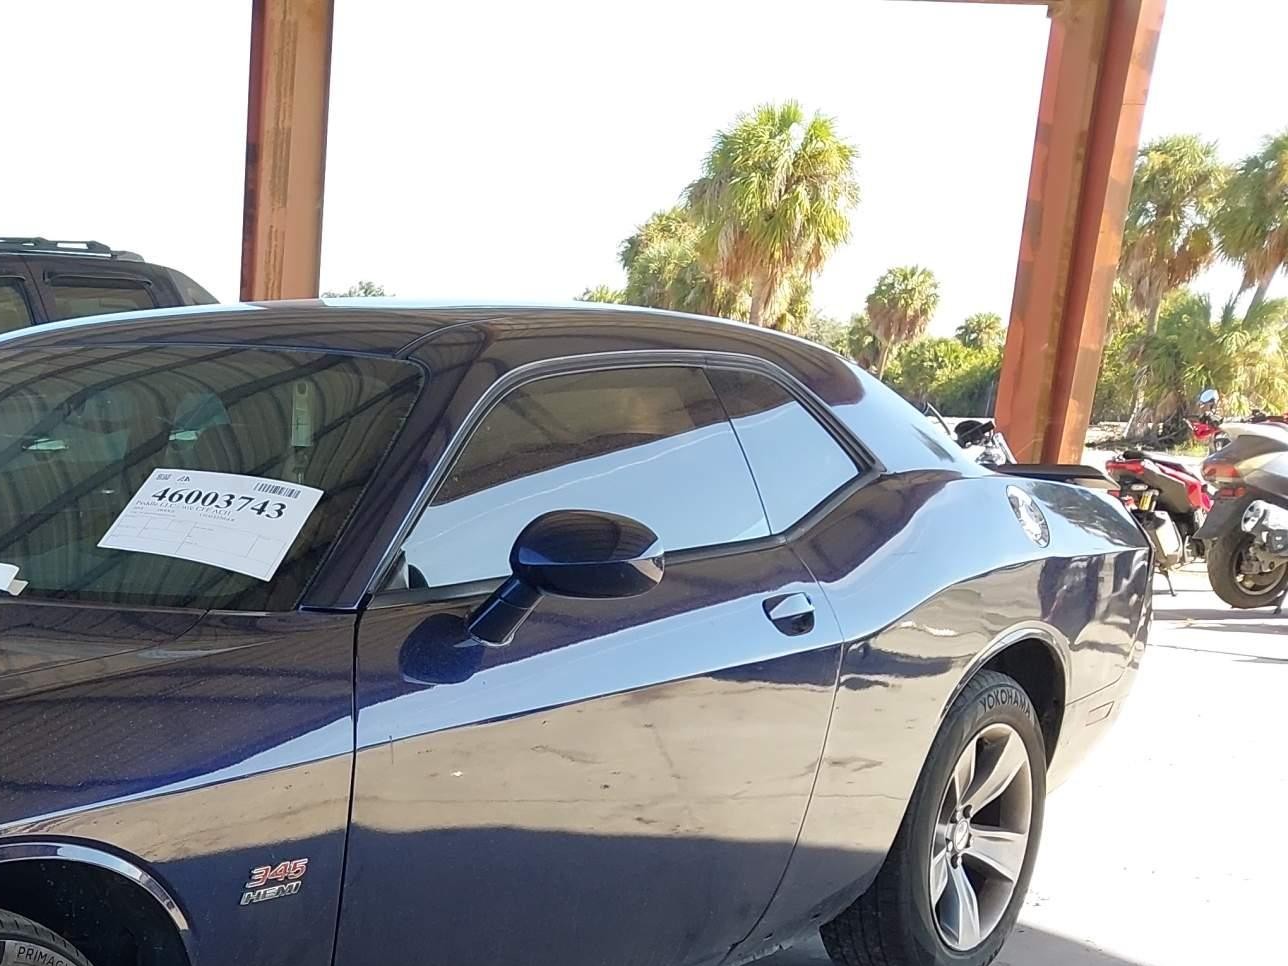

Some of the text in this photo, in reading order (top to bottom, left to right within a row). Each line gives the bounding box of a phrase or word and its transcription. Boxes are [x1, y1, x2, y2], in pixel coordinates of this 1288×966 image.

[152, 487, 287, 519] 46003743
[980, 688, 1031, 718] YOKOHAMA
[245, 858, 308, 888] 345
[240, 881, 301, 905] HEMI
